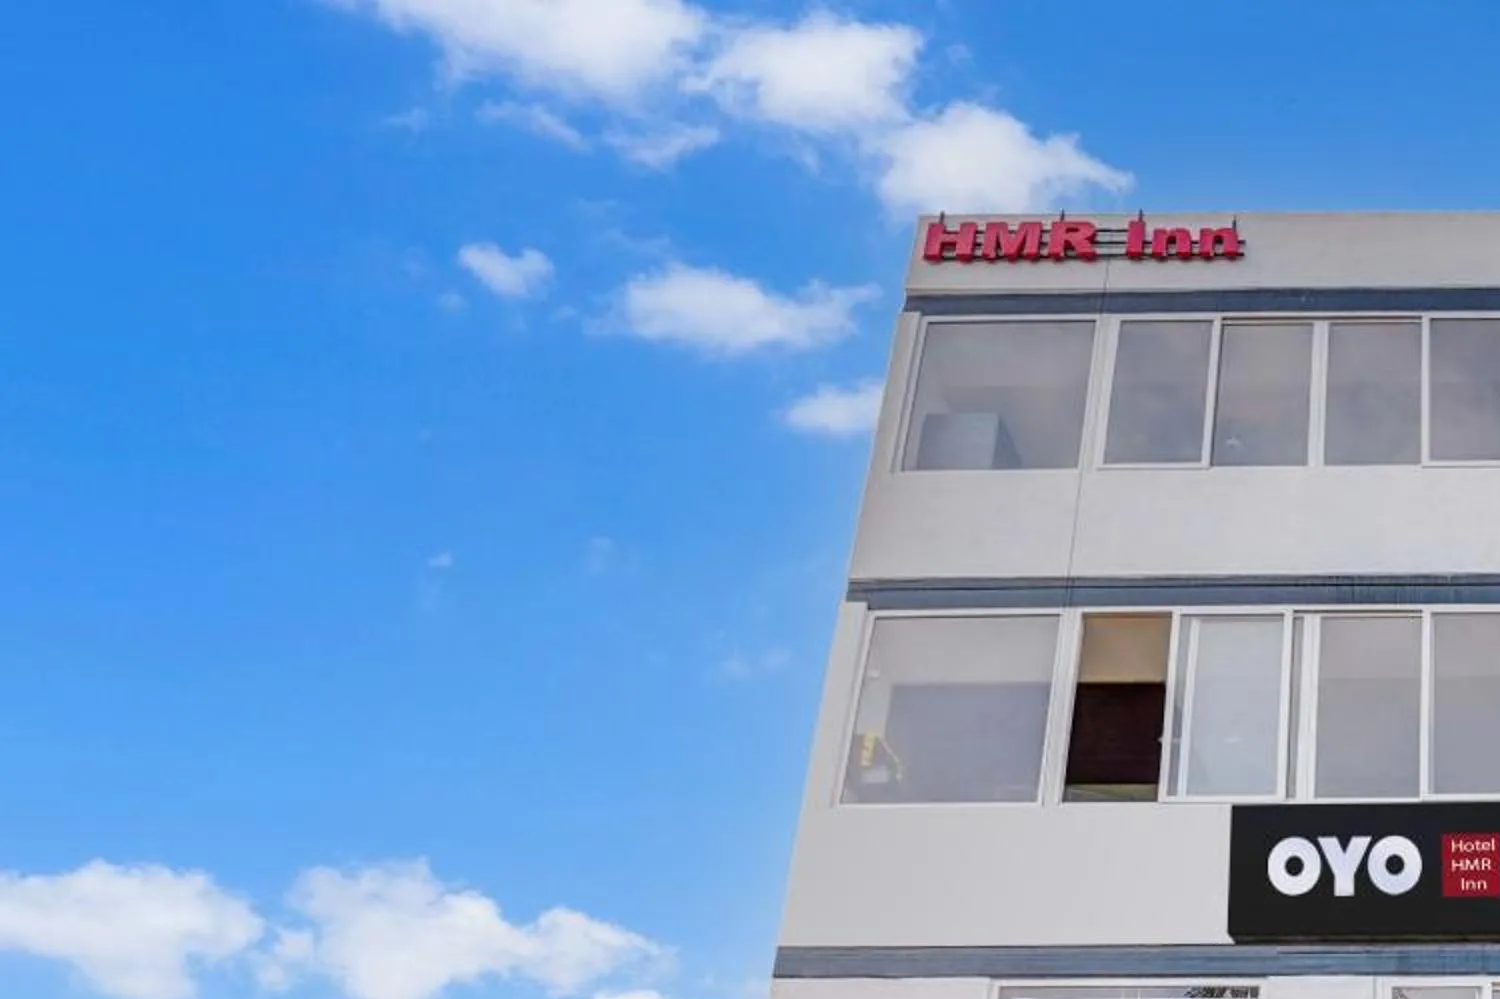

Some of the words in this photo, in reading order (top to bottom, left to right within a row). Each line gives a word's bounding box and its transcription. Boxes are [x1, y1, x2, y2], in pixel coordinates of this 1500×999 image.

[924, 220, 1100, 263] HMR
[1125, 219, 1242, 261] Inn
[1451, 838, 1496, 853] Hotel
[1267, 835, 1423, 897] OYO
[1451, 858, 1493, 872] HMR
[1461, 877, 1488, 891] Inn
